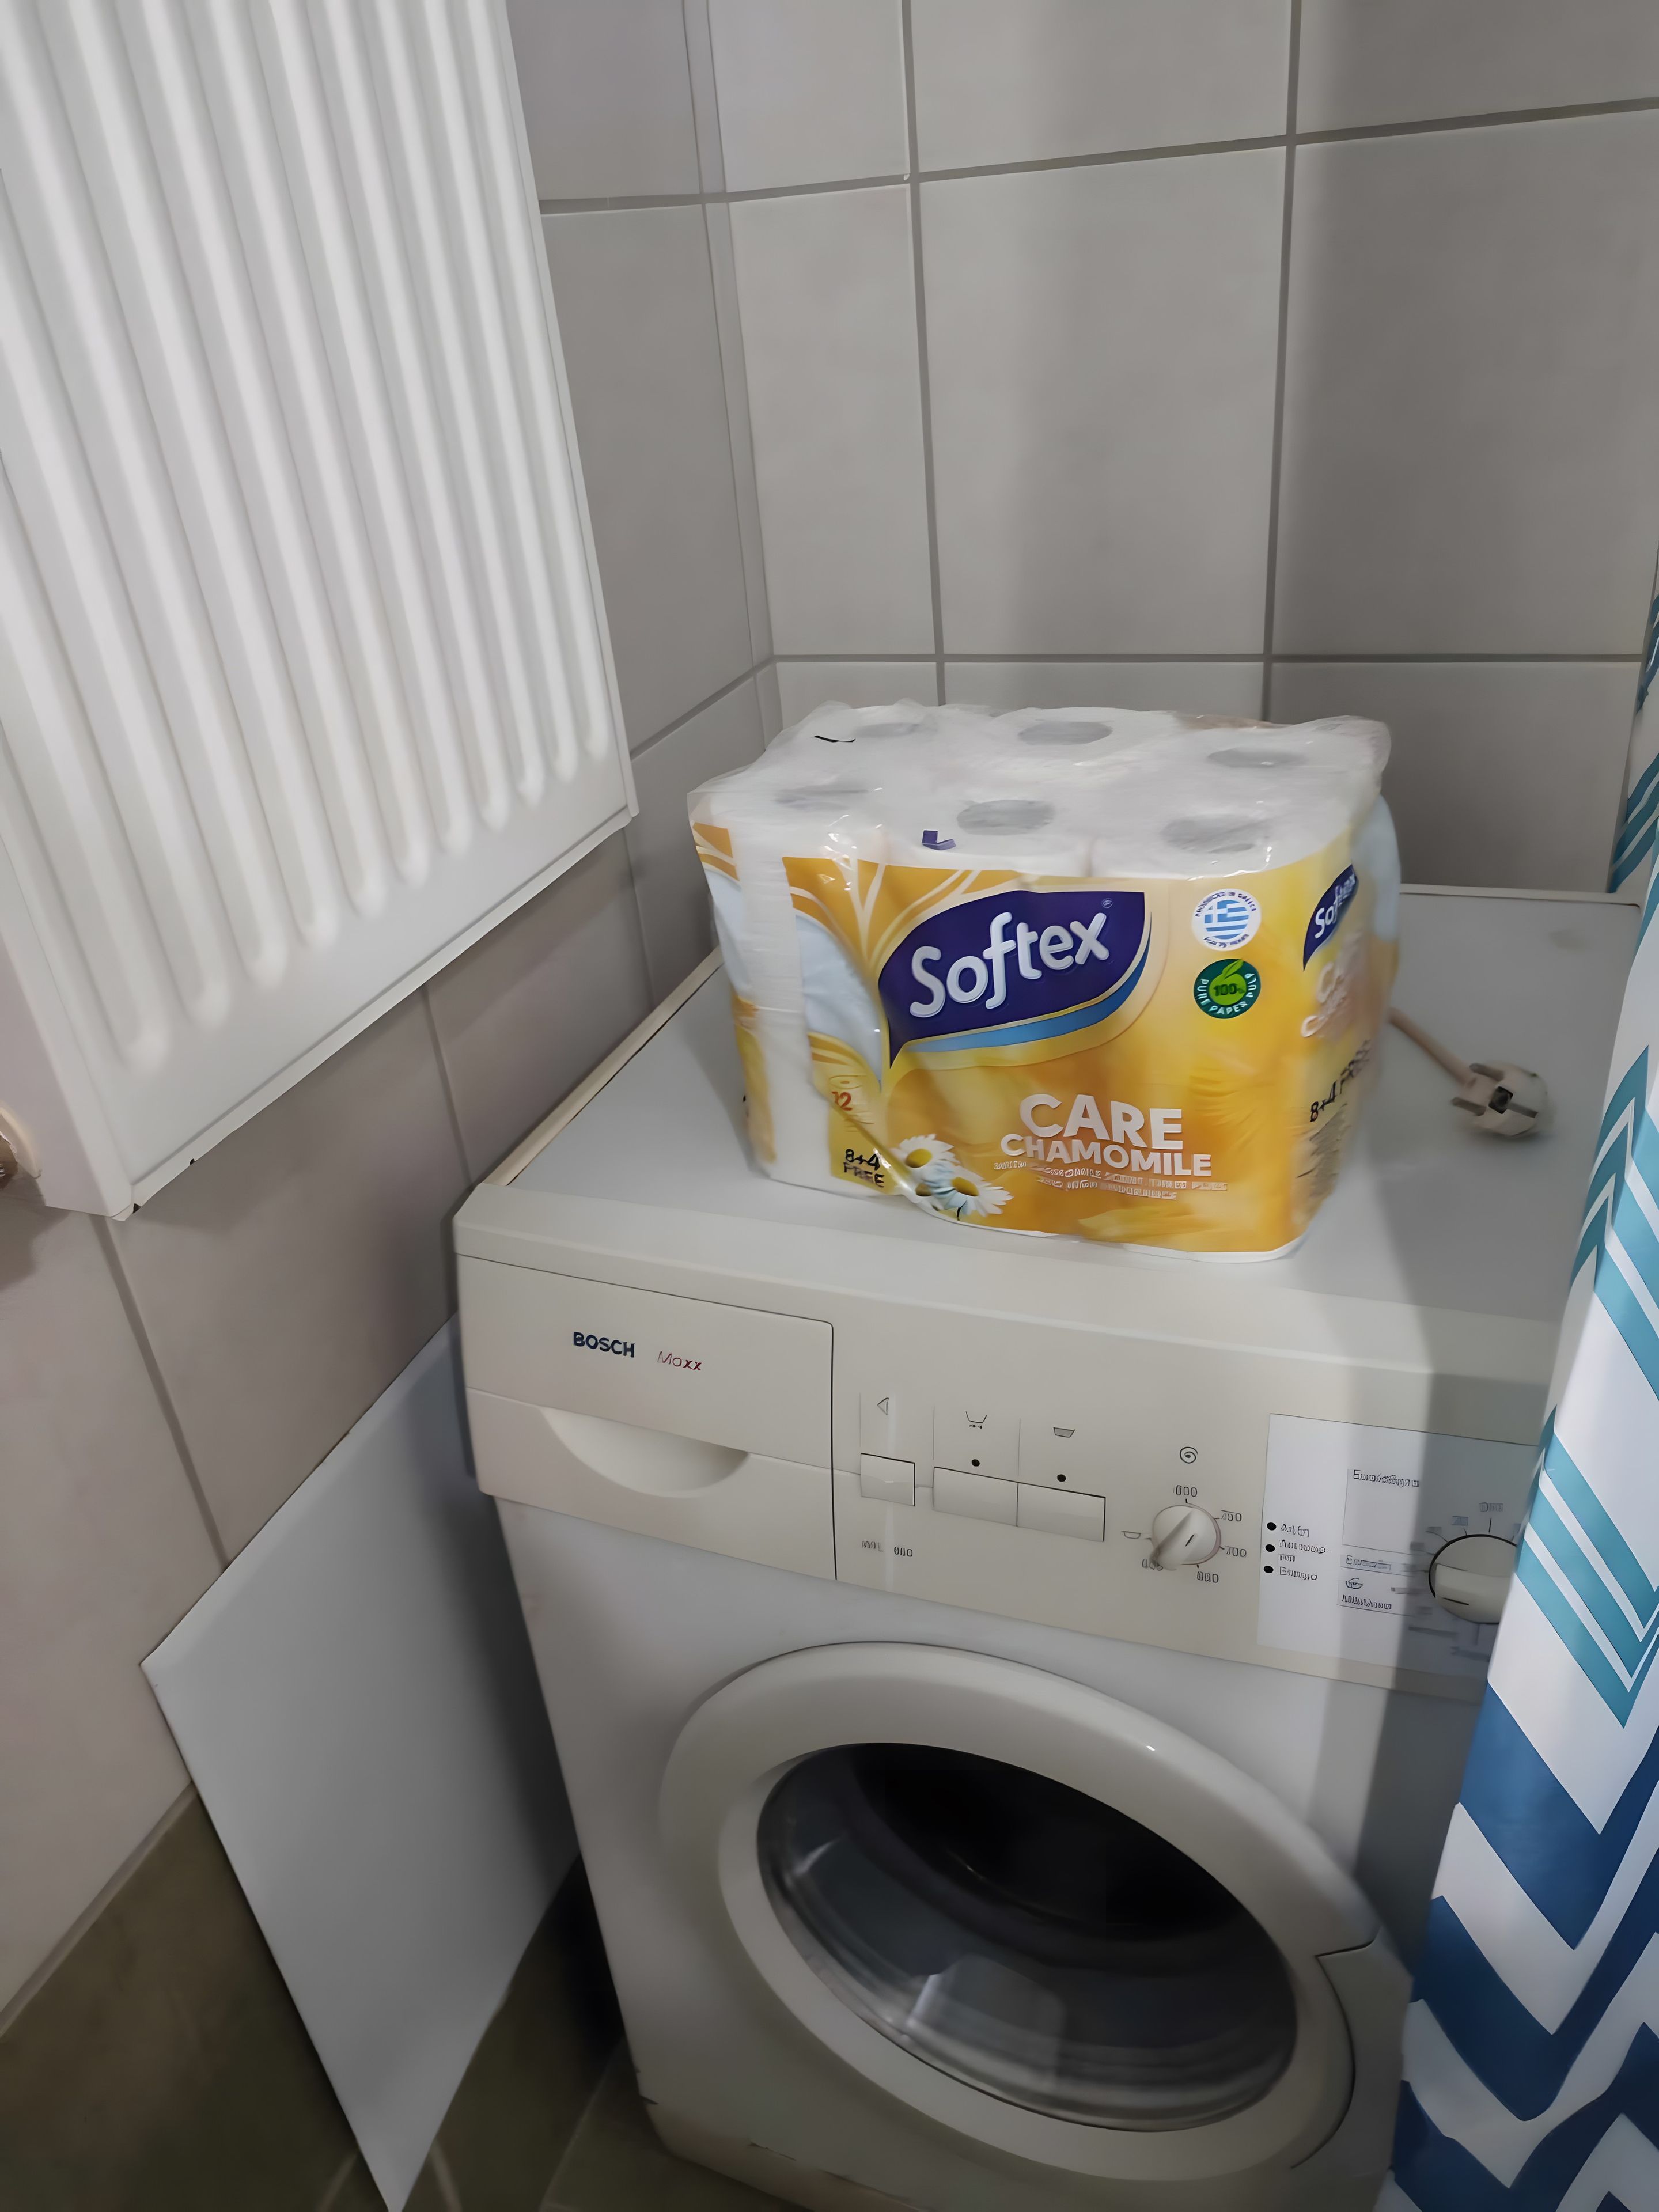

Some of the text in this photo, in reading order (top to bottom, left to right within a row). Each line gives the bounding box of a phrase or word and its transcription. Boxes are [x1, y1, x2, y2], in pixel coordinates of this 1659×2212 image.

[909, 911, 1110, 1018] Softex
[1019, 1093, 1183, 1150] CARE
[845, 1148, 881, 1171] 8+4
[1000, 1133, 1212, 1177] CHAMOMILE
[573, 1331, 635, 1358] BOSCH
